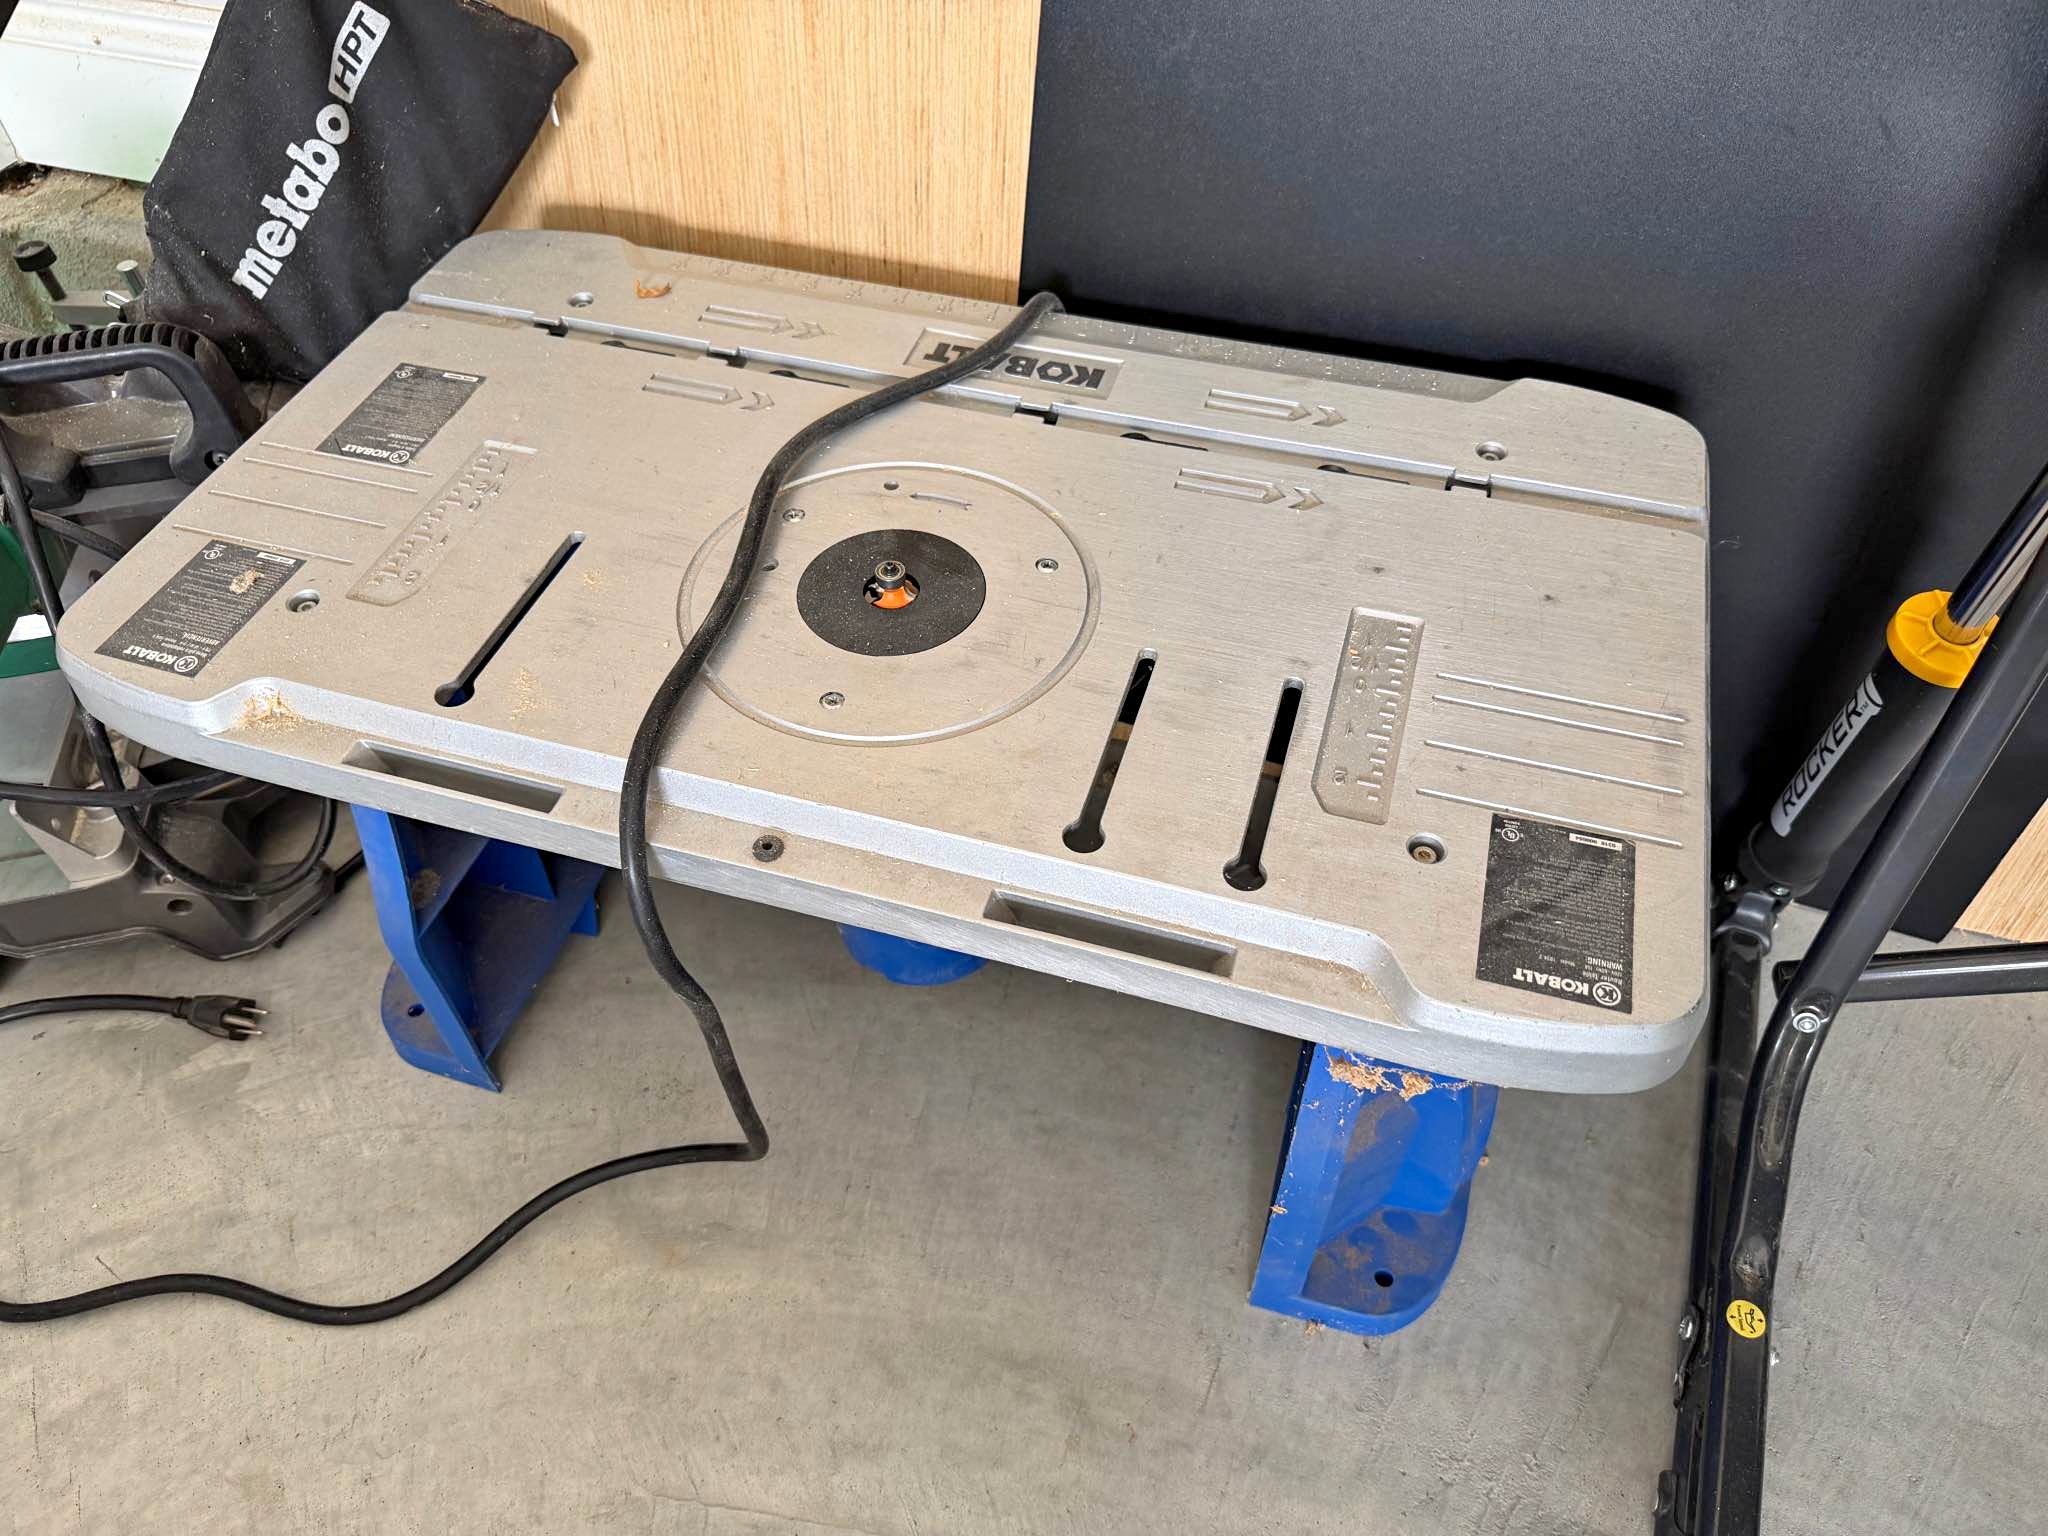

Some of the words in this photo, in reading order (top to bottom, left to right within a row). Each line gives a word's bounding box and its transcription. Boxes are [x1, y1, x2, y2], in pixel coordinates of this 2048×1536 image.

[232, 103, 350, 300] metabo
[333, 10, 378, 95] HPT
[340, 443, 390, 459] KOBALT
[122, 644, 179, 666] KOBALT
[1781, 693, 1863, 817] ROCKER
[1512, 967, 1589, 996] KOBALT
